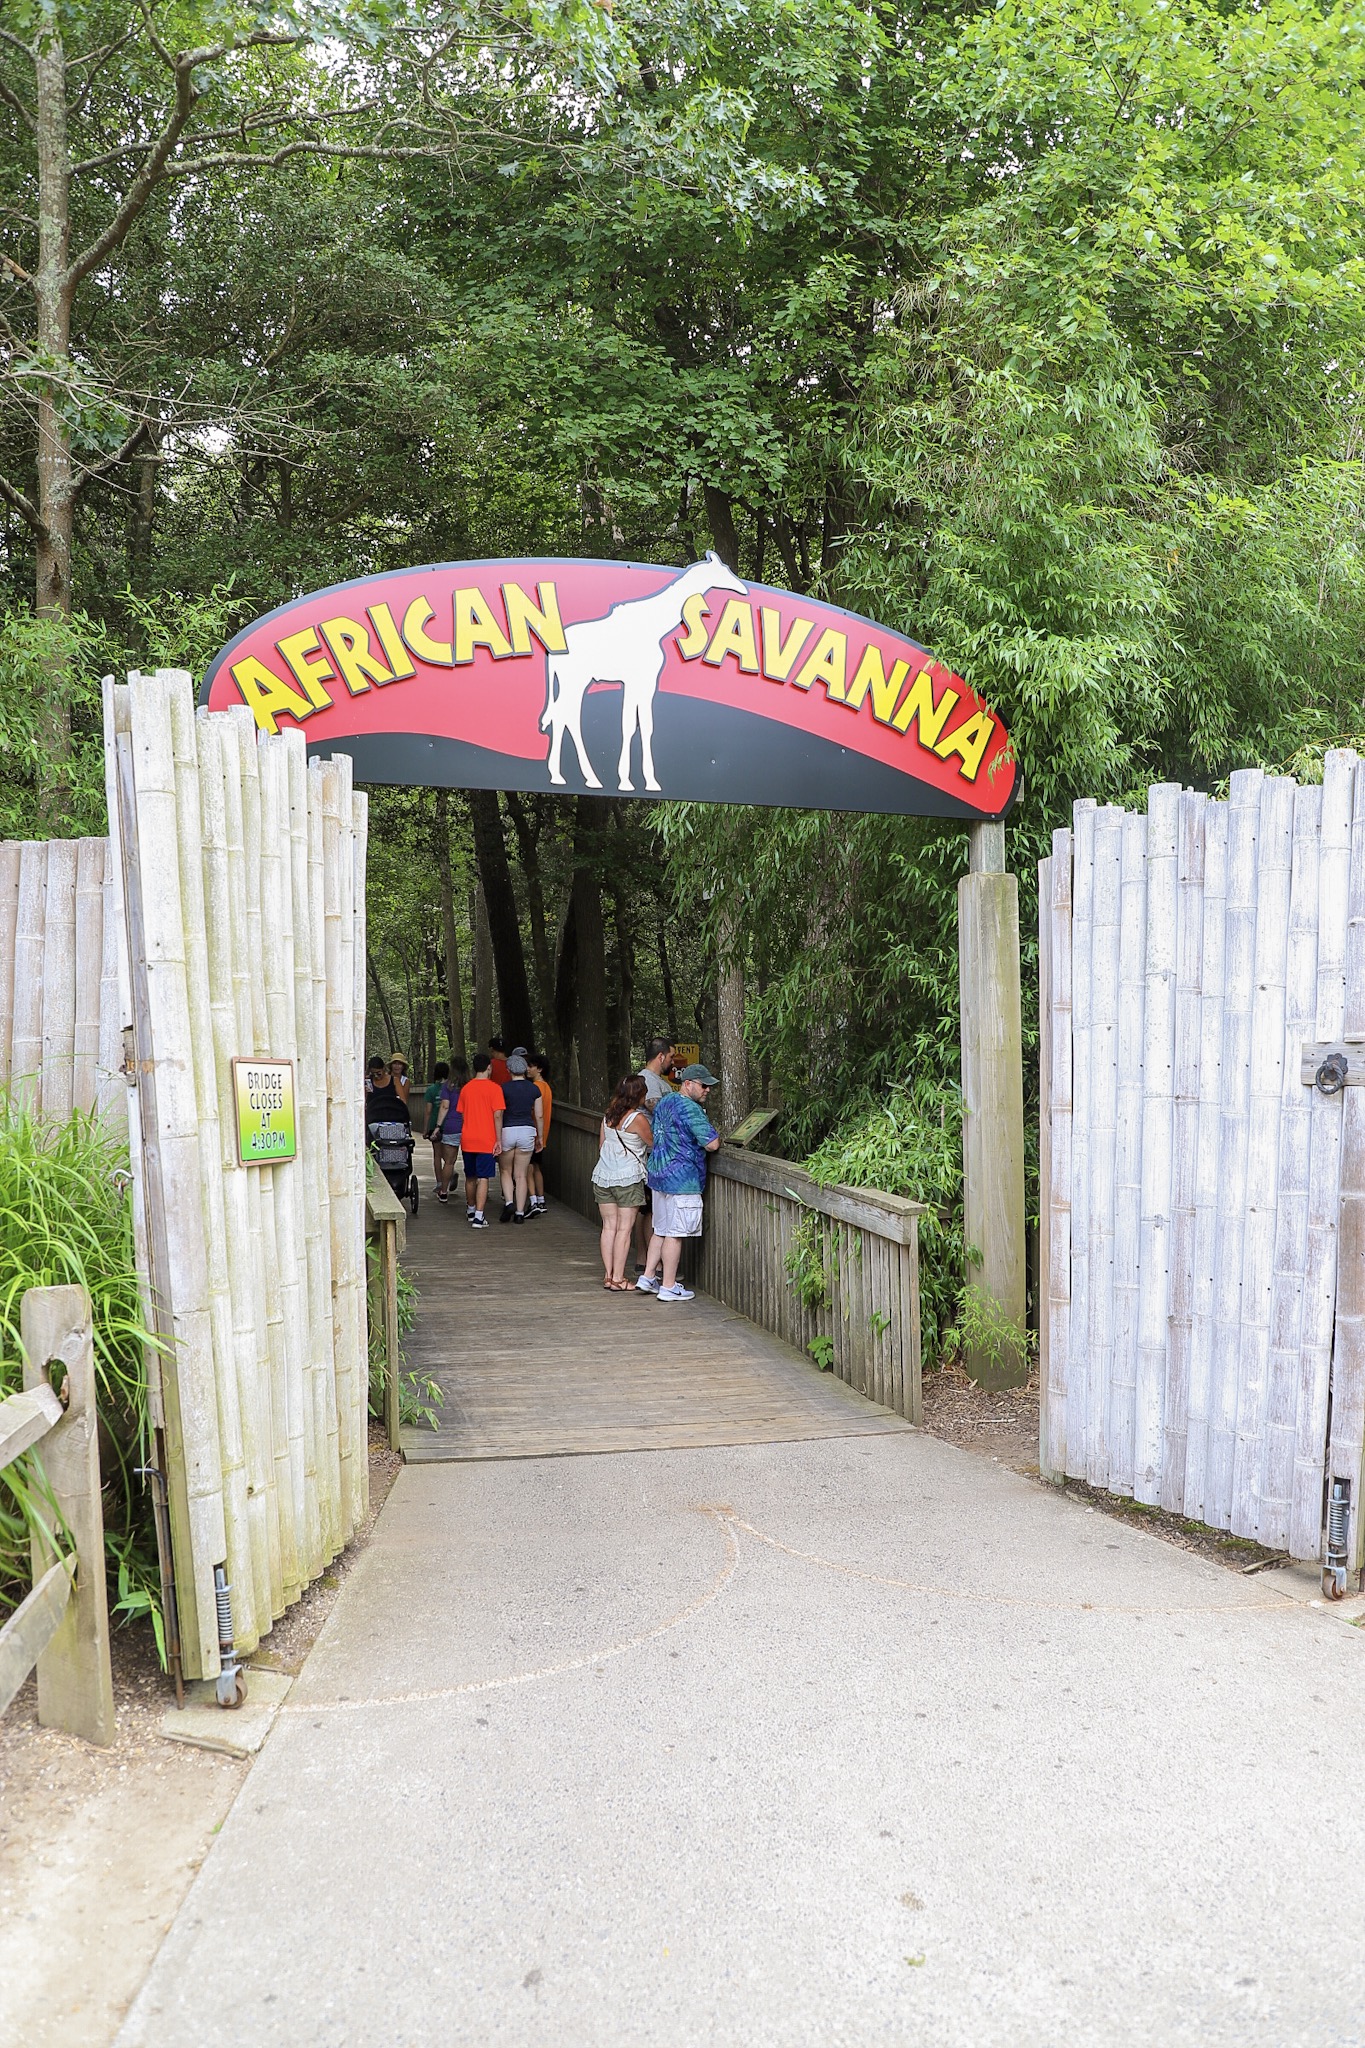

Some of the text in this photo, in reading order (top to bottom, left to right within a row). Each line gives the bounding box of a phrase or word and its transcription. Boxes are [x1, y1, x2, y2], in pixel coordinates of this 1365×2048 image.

[229, 581, 996, 783] AFRICAN SAVANNA
[247, 1071, 282, 1090] BRIDGE
[250, 1093, 283, 1110] CLOSES
[261, 1112, 271, 1129] AT
[252, 1131, 286, 1150] 4:30PM
